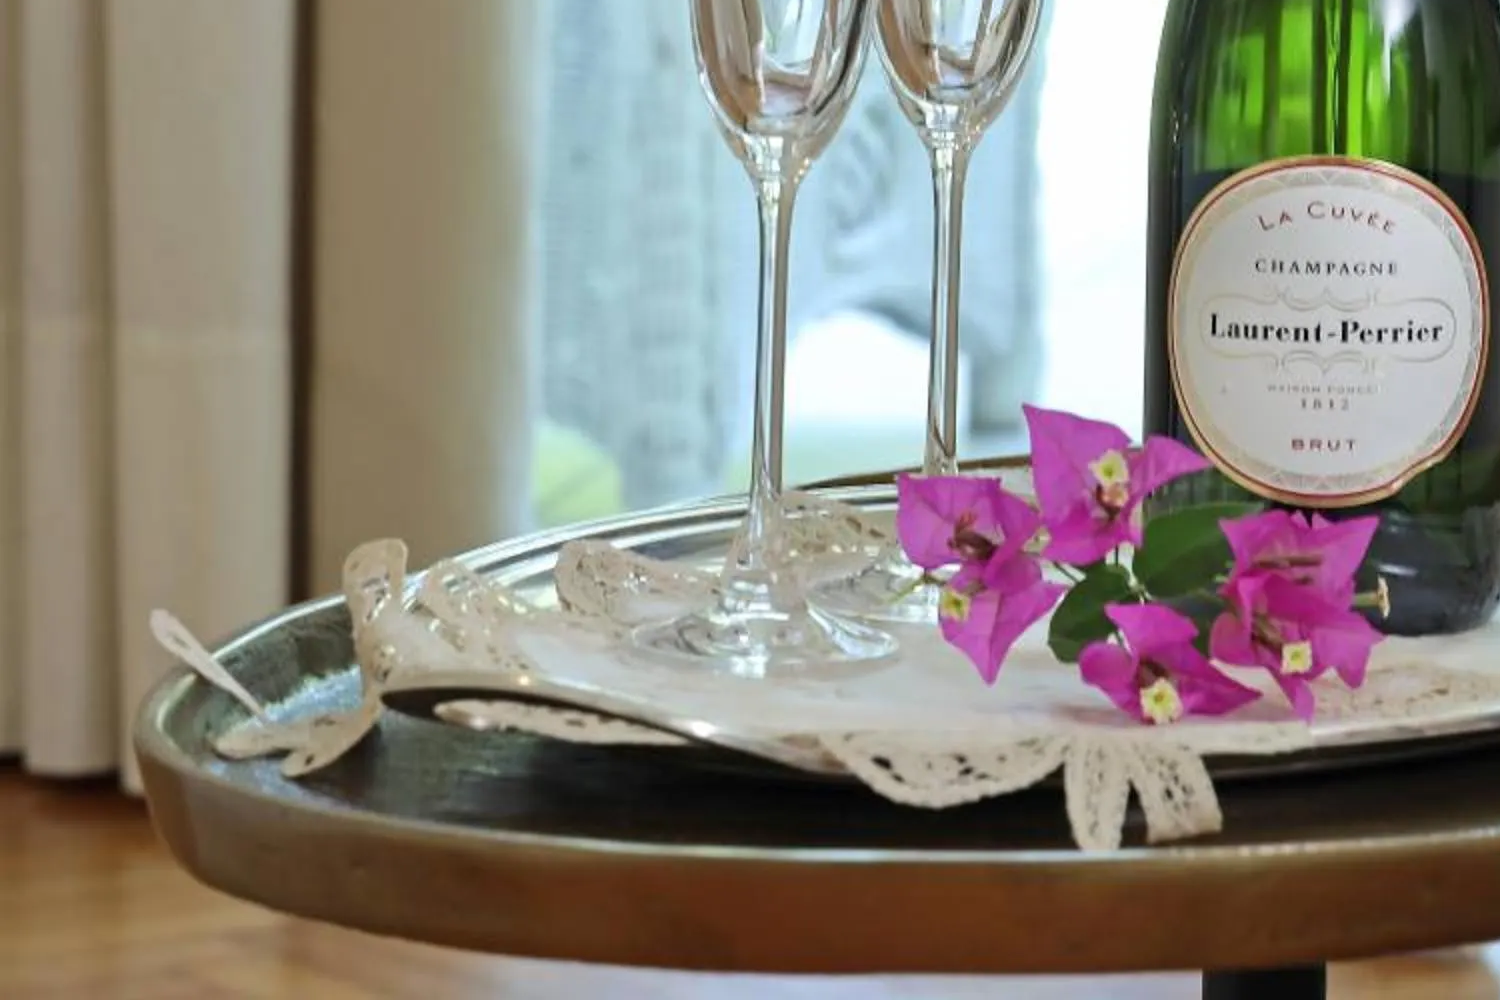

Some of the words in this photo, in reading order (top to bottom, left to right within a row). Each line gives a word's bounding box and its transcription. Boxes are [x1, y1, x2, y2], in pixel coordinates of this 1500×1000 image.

[1258, 210, 1293, 232] LA
[1255, 259, 1398, 276] CHAMPAGNE
[1210, 313, 1444, 345] Laurent-Perrier
[1301, 397, 1350, 411] 1812
[1291, 438, 1357, 452] BRUT
